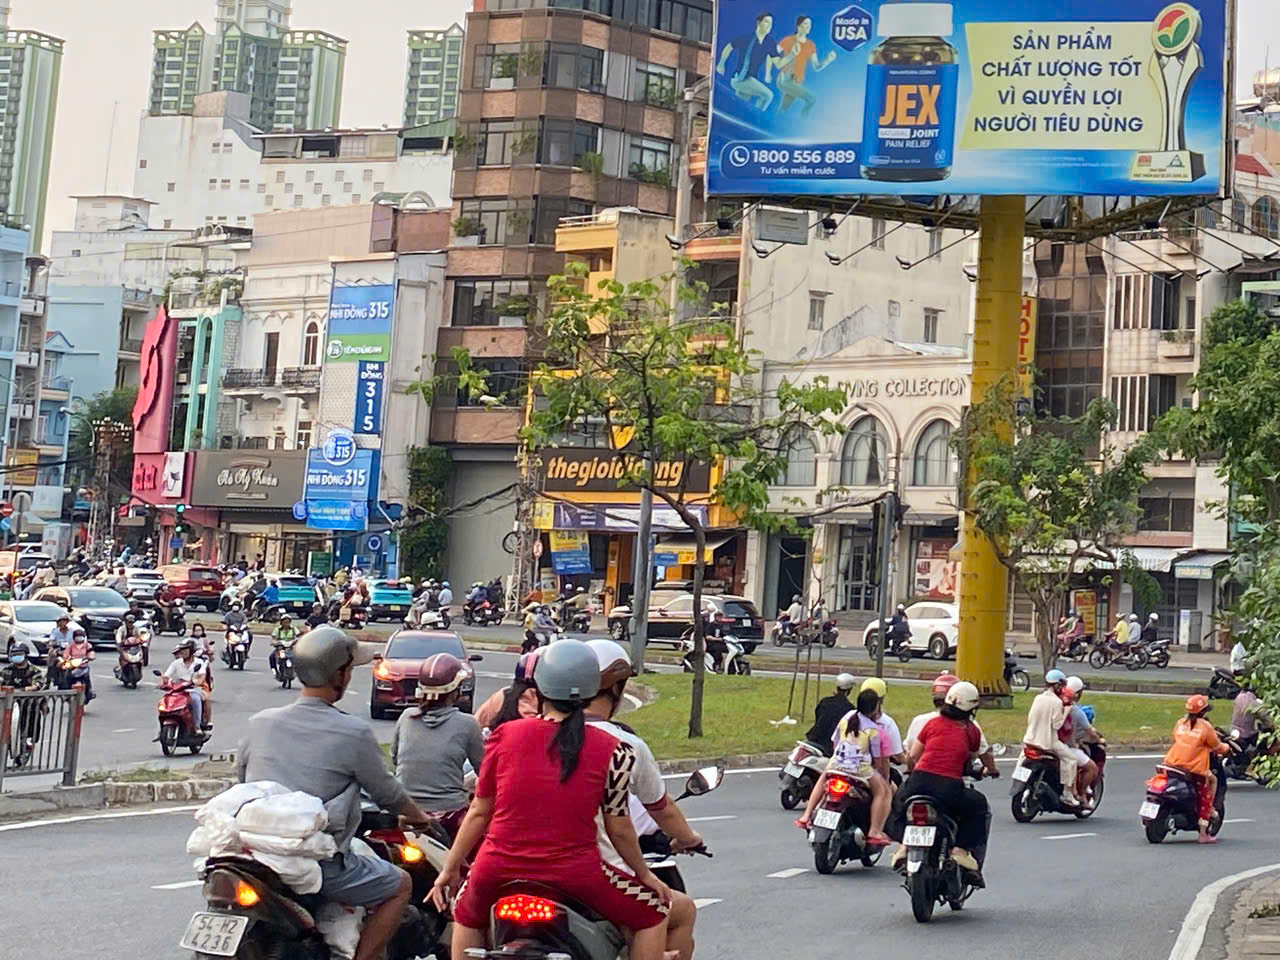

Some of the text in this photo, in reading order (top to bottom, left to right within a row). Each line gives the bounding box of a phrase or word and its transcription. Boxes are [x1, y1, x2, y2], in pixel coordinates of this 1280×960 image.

[835, 26, 868, 41] USA
[1012, 26, 1112, 50] SẢN PHẨM
[982, 55, 1142, 81] CHẤT LƯỢNG TỐT
[998, 82, 1122, 110] VÌ QUYỀN LỢI
[878, 84, 941, 126] JEX
[974, 112, 1143, 132] NGƯỜI TIÊU DÙNG
[912, 129, 940, 138] JOINT
[885, 140, 931, 148] PAIN RELIEF
[752, 150, 856, 164] 1800 556 889
[760, 166, 772, 174] Tư
[369, 302, 389, 318] 315
[886, 377, 966, 398] COLLECTION
[336, 446, 350, 458] 315
[345, 469, 365, 486] 315
